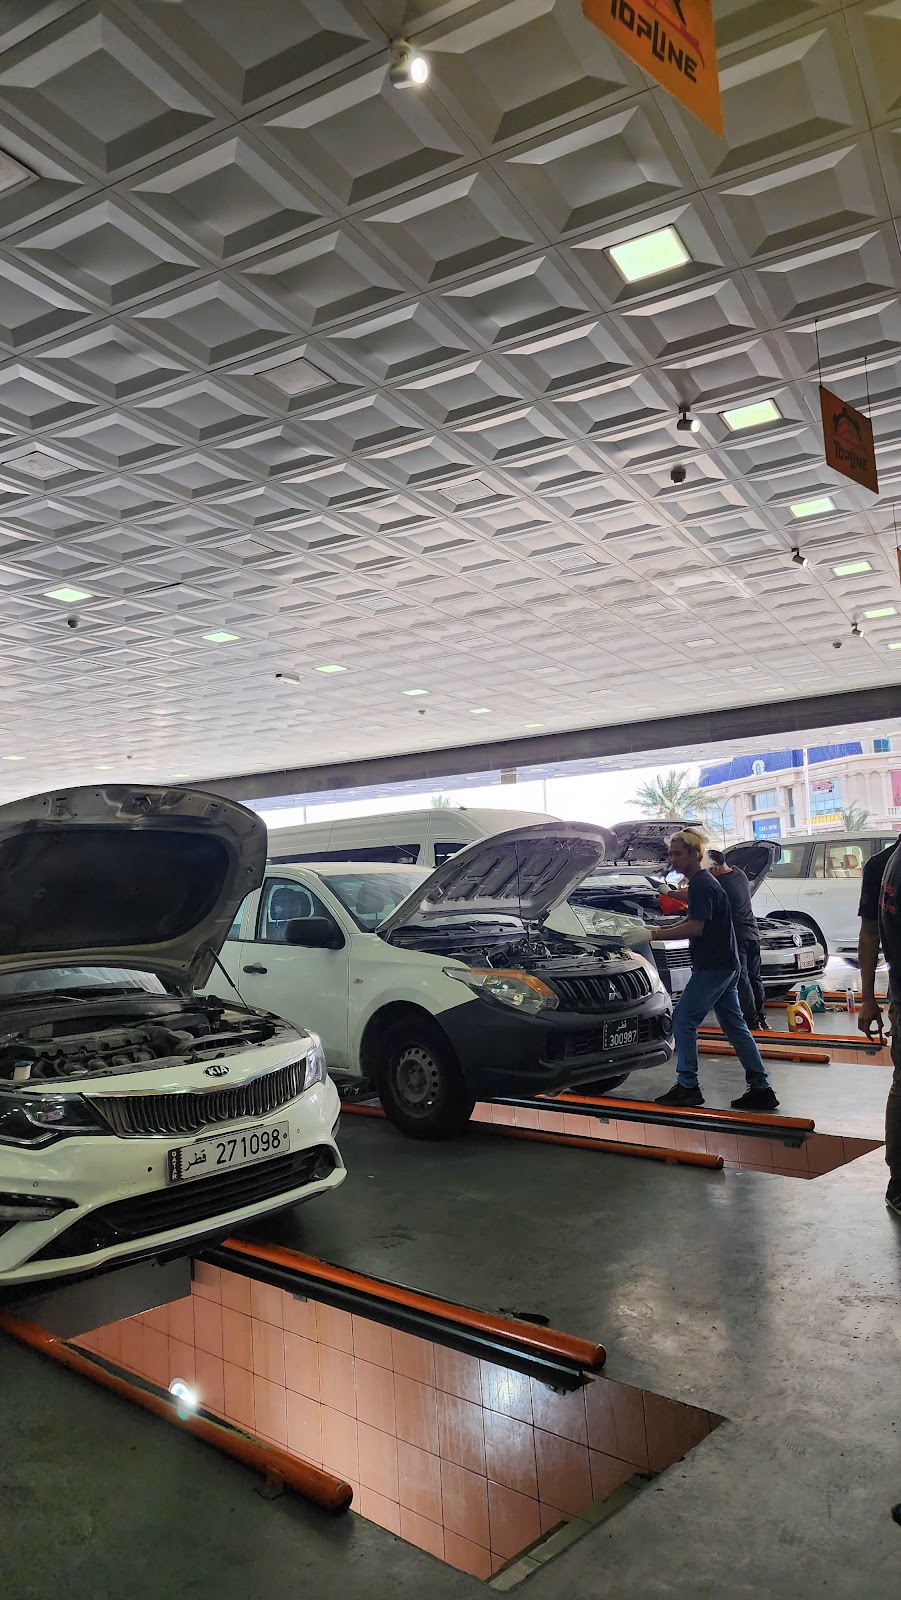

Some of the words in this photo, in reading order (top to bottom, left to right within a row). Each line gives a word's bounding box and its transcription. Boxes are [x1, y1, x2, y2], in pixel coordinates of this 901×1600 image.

[833, 440, 868, 472] TOPLINE
[609, 1030, 637, 1047] 300987
[206, 1065, 229, 1076] KIA
[216, 1129, 280, 1165] 271098
[185, 1149, 207, 1171] قطر
